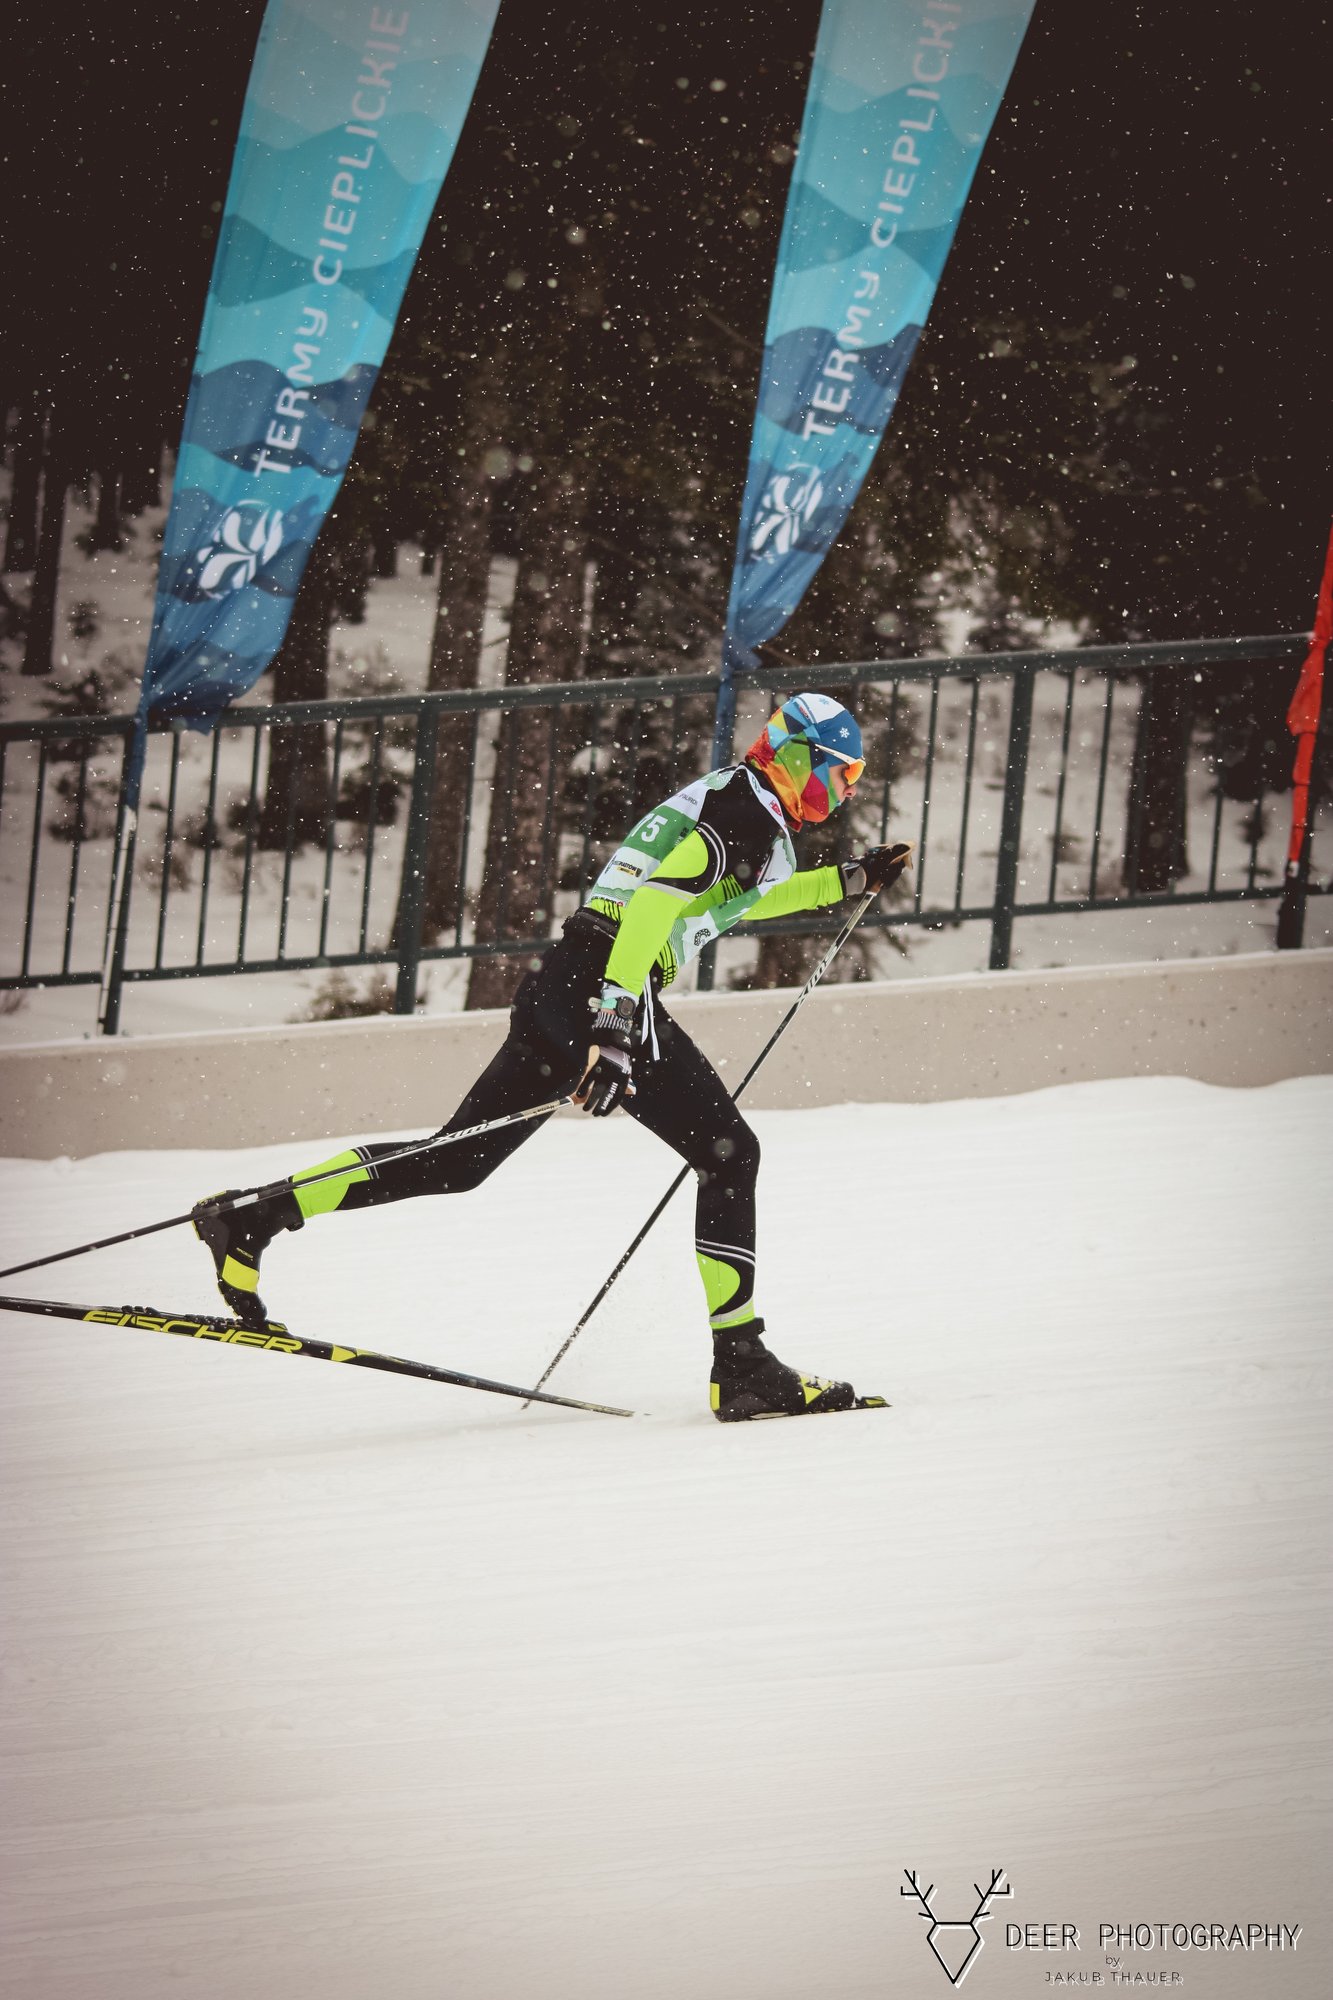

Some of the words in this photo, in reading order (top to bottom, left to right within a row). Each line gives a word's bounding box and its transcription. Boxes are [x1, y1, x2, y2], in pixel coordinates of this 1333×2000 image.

[254, 305, 330, 478] TERMY
[311, 5, 412, 288] CIEPLICKIE
[803, 270, 881, 441] TERMY
[82, 1310, 303, 1353] FISCHER
